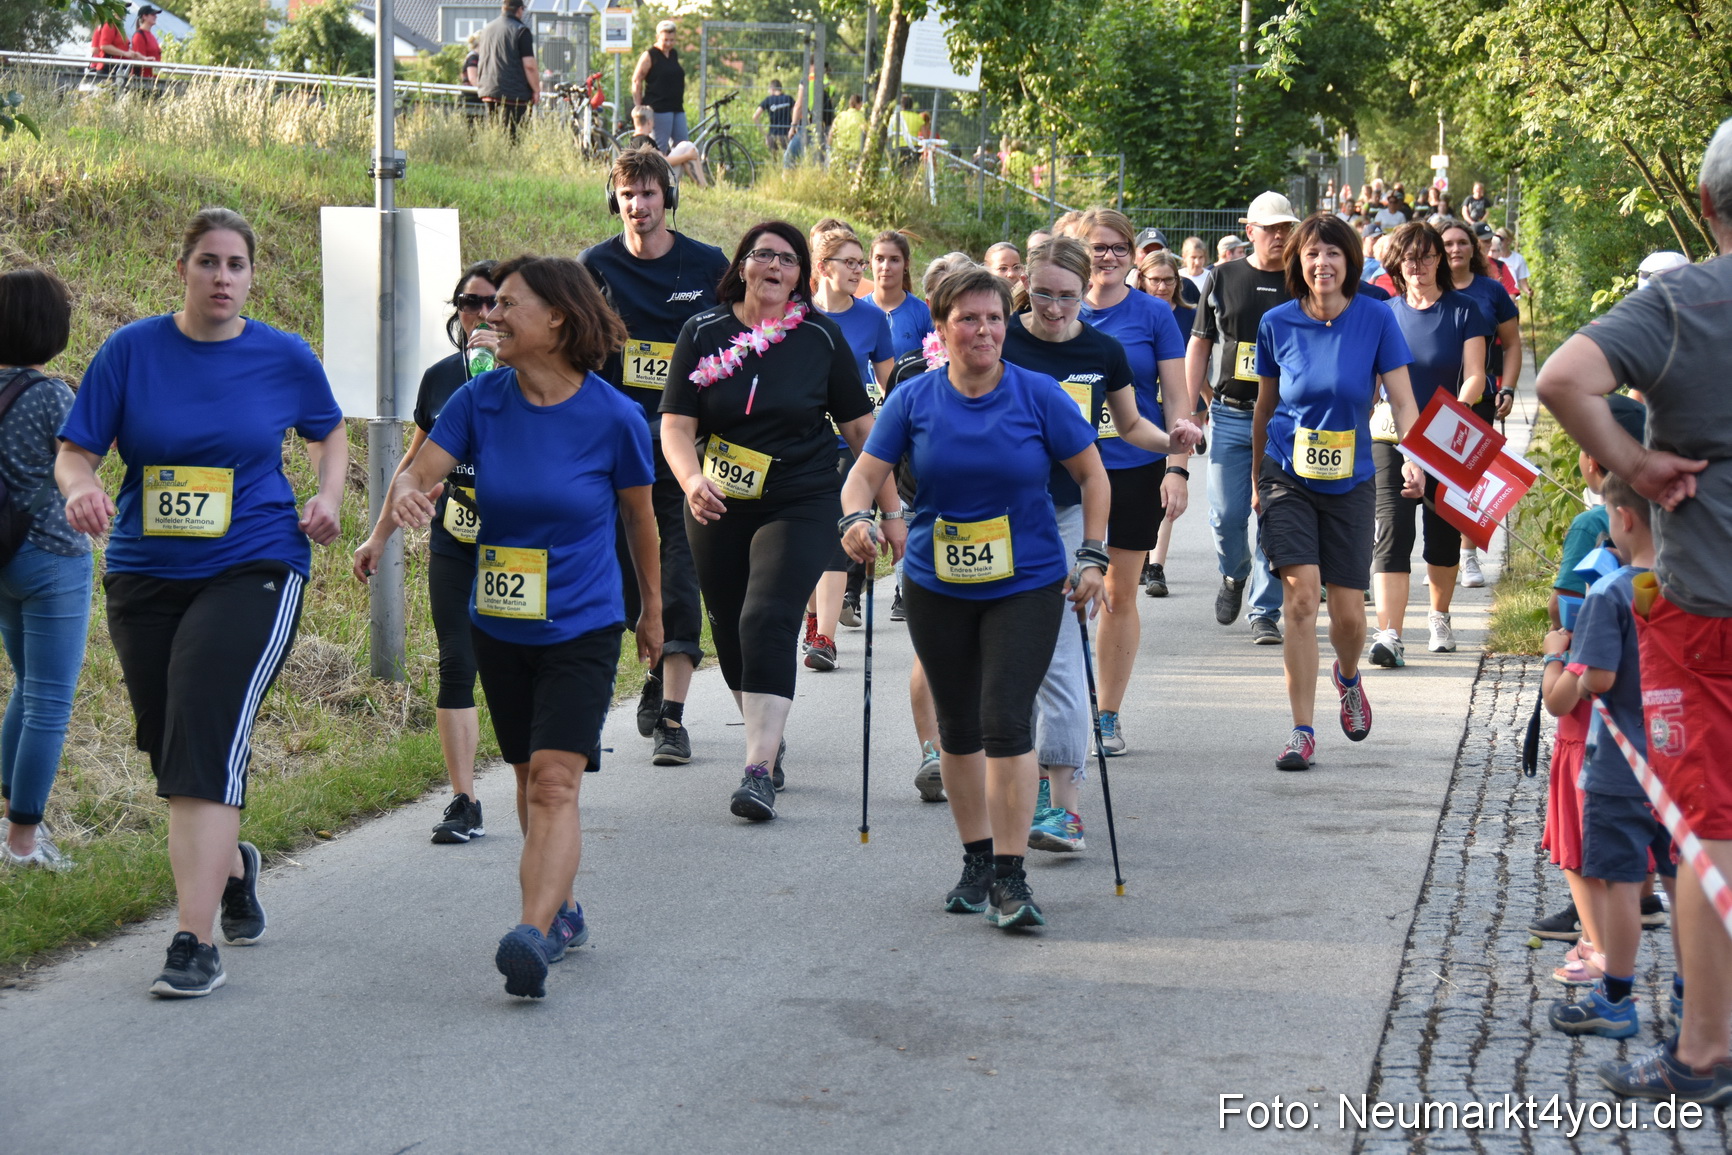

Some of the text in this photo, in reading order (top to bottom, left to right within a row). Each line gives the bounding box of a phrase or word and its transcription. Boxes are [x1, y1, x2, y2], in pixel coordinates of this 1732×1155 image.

[633, 357, 668, 376] 142
[1306, 447, 1342, 466] 866
[1466, 453, 1480, 470] DEHN
[711, 456, 755, 489] 1994
[159, 491, 210, 517] 857
[185, 517, 214, 525] Ramona
[946, 543, 994, 567] 854
[974, 565, 993, 573] Heike
[484, 571, 526, 598] 862
[503, 598, 527, 607] Martina
